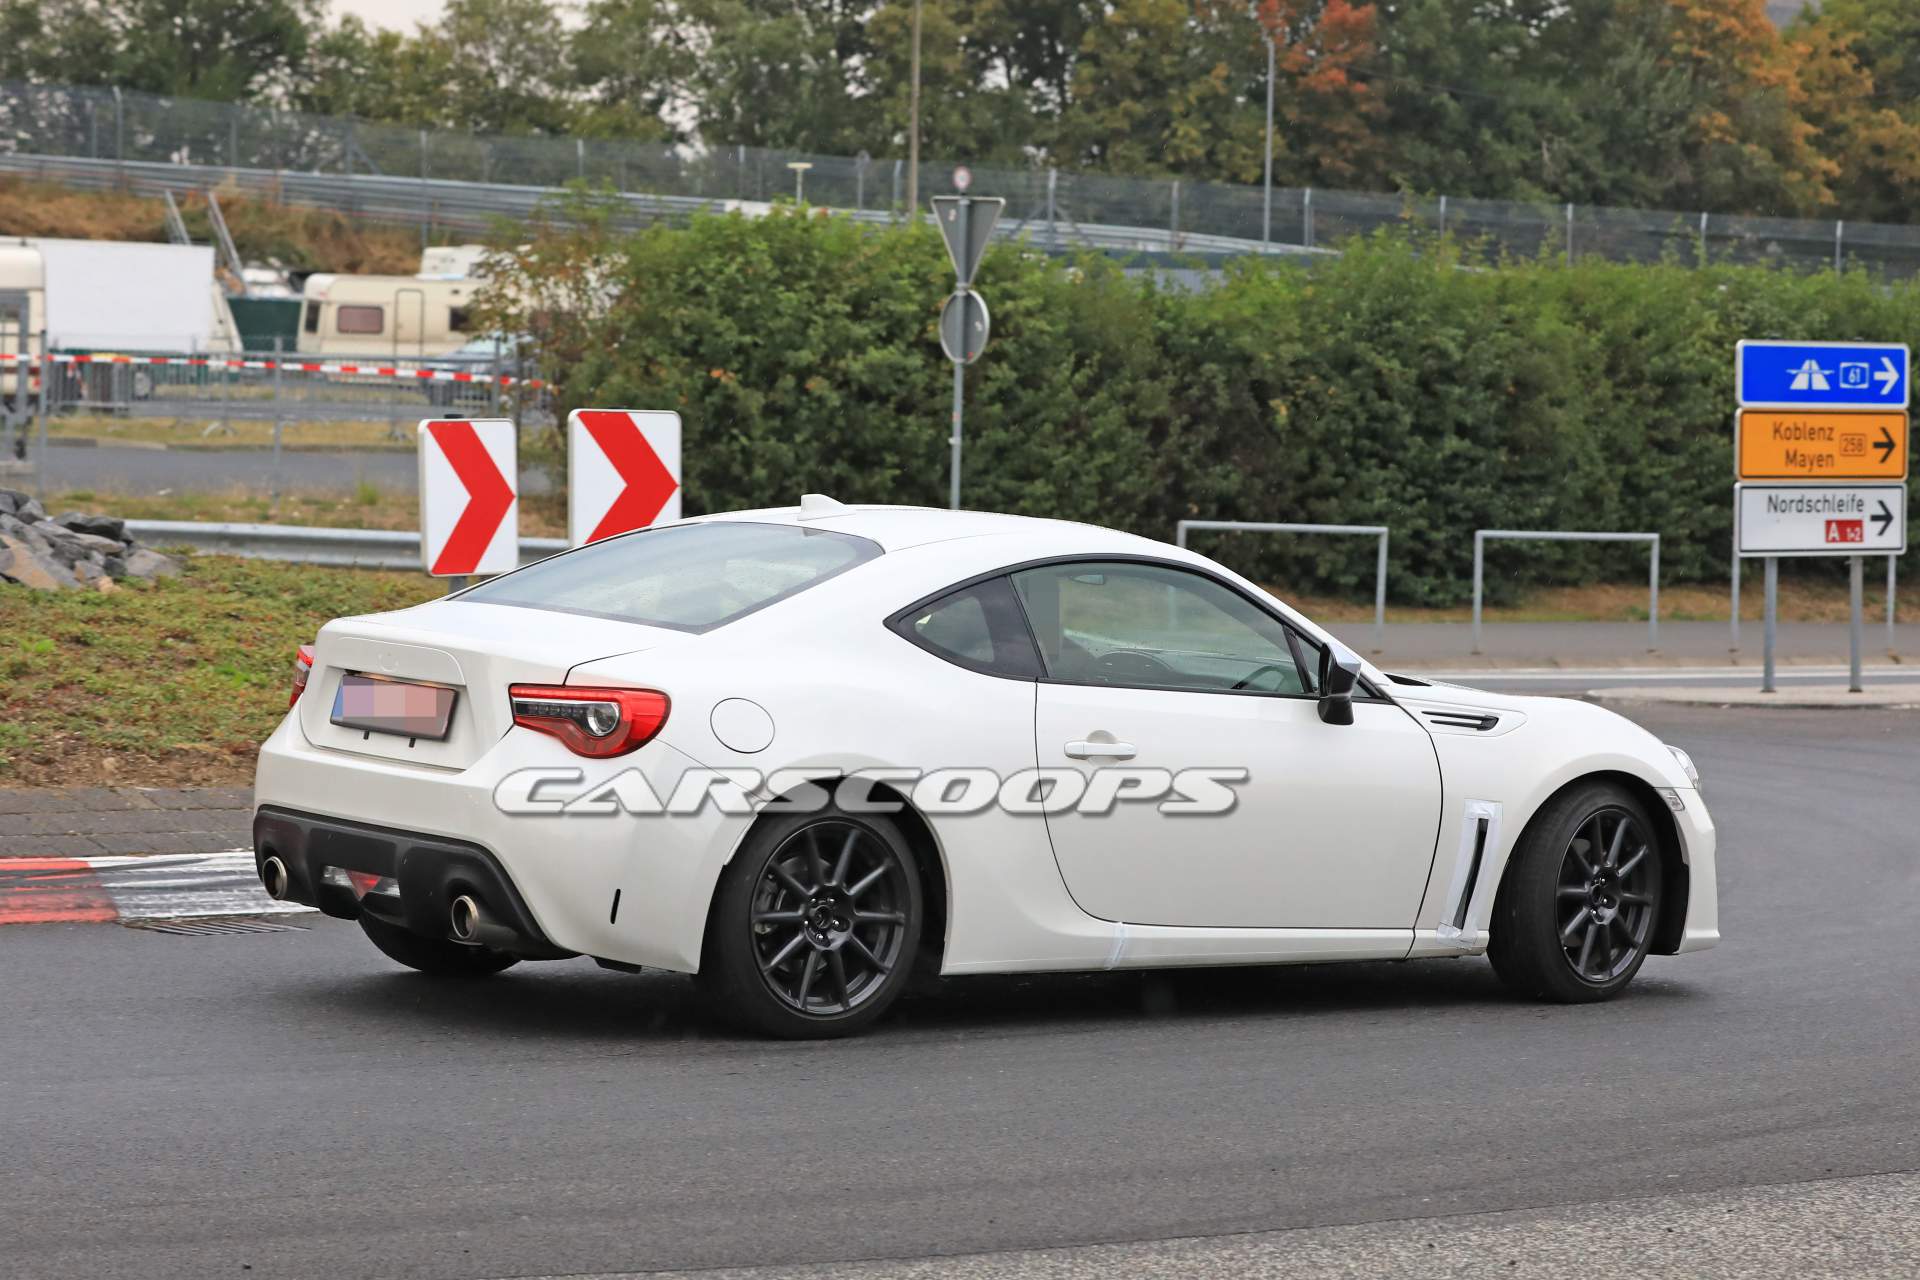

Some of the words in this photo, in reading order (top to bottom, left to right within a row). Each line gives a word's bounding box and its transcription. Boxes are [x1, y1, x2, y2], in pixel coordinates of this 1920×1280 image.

[1848, 368, 1861, 383] 61
[1772, 422, 1835, 441] Koblenz
[1842, 437, 1865, 453] 258
[1785, 450, 1835, 472] Mayen
[1767, 494, 1865, 513] Nordschleife
[1827, 521, 1840, 541] A
